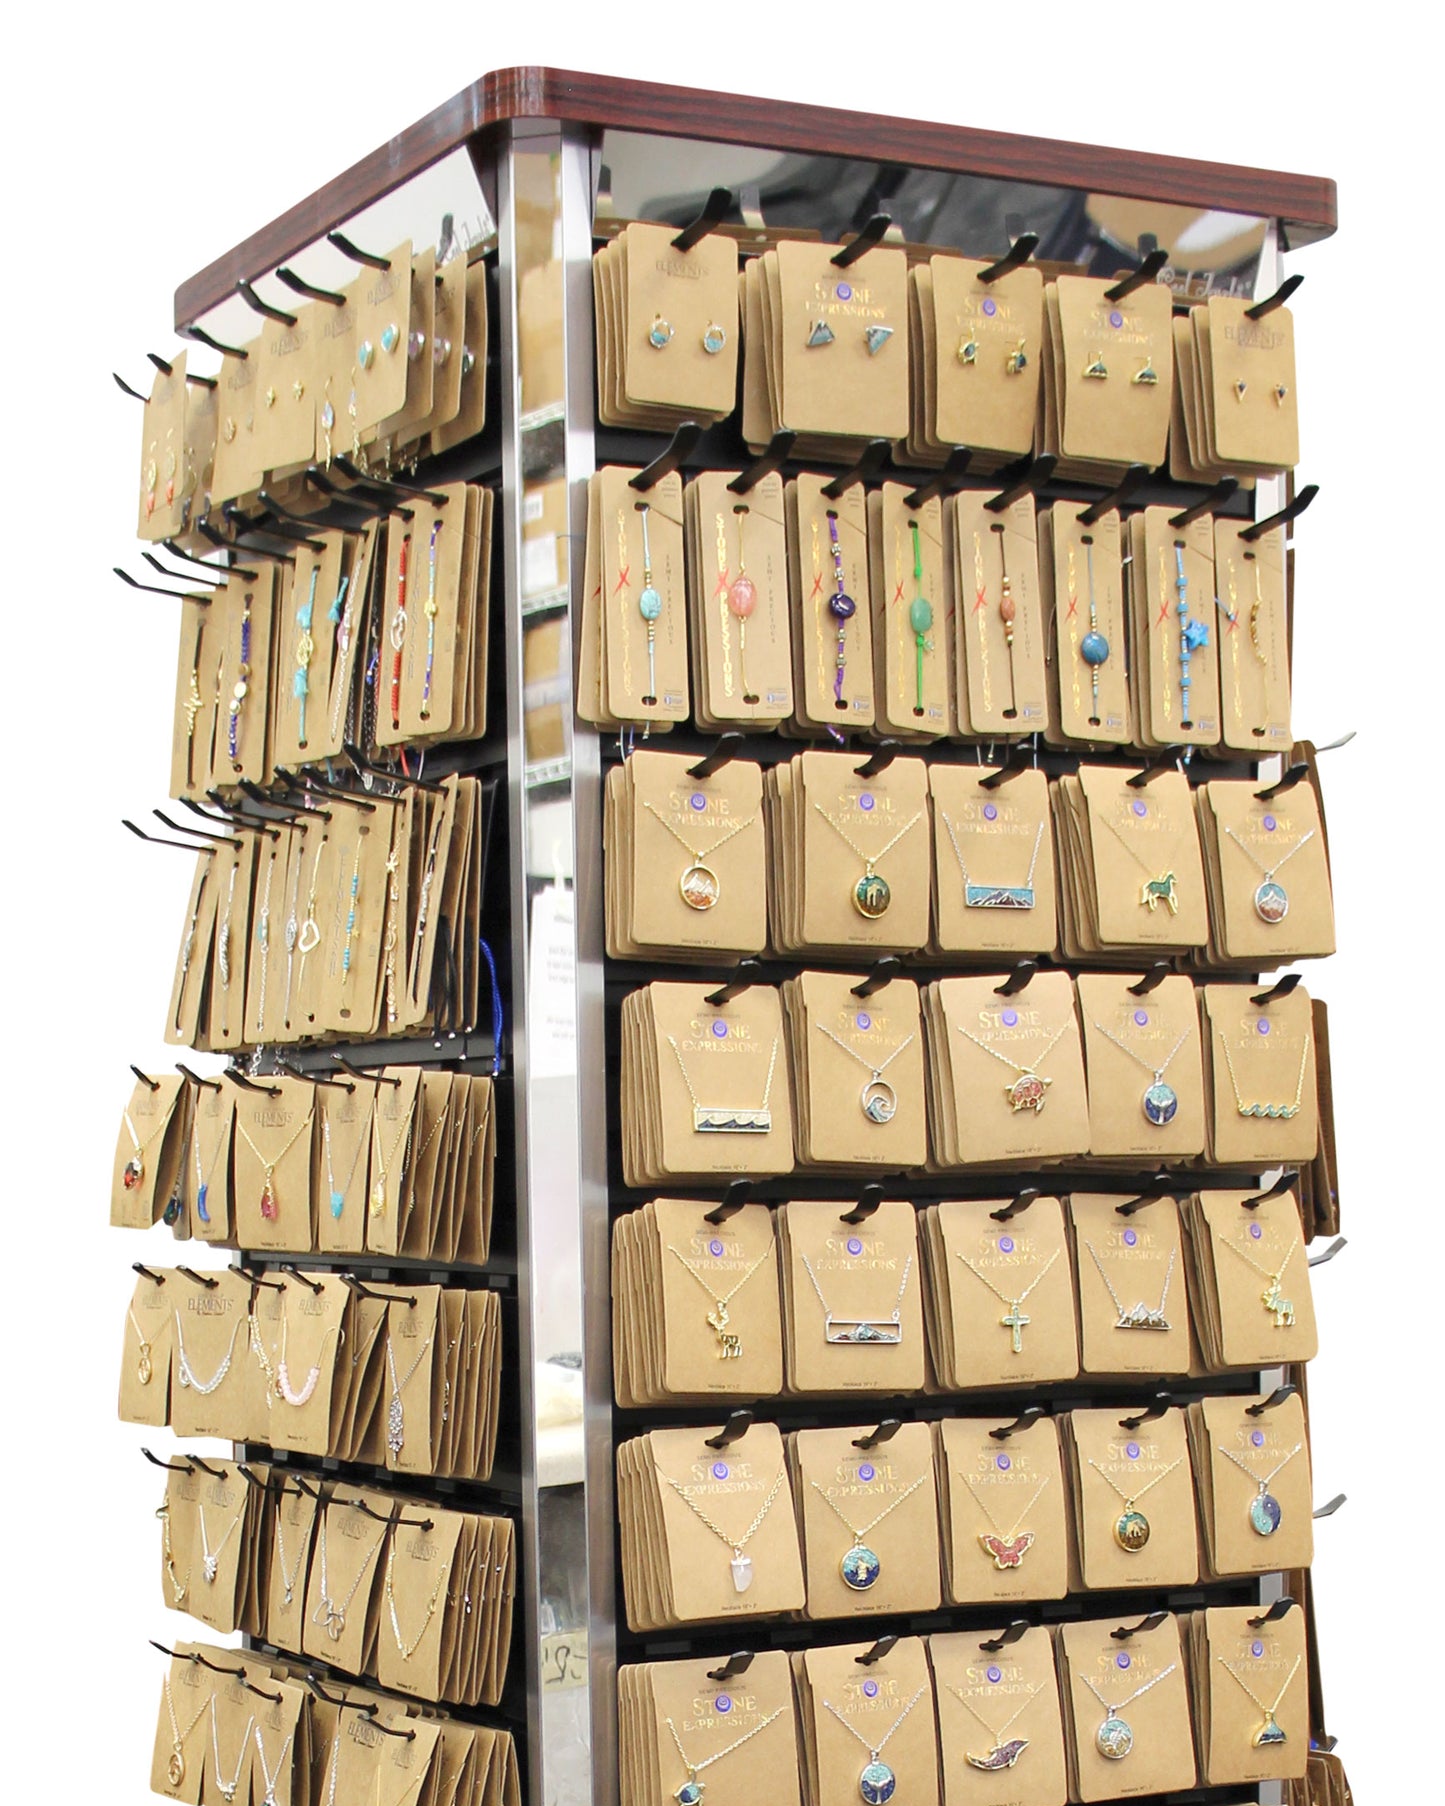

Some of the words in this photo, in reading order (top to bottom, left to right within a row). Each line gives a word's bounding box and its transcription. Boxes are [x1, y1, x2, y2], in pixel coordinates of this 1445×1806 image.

[669, 790, 728, 815] STONE
[978, 1011, 1040, 1030] STONE
[692, 1696, 758, 1717] STONE
